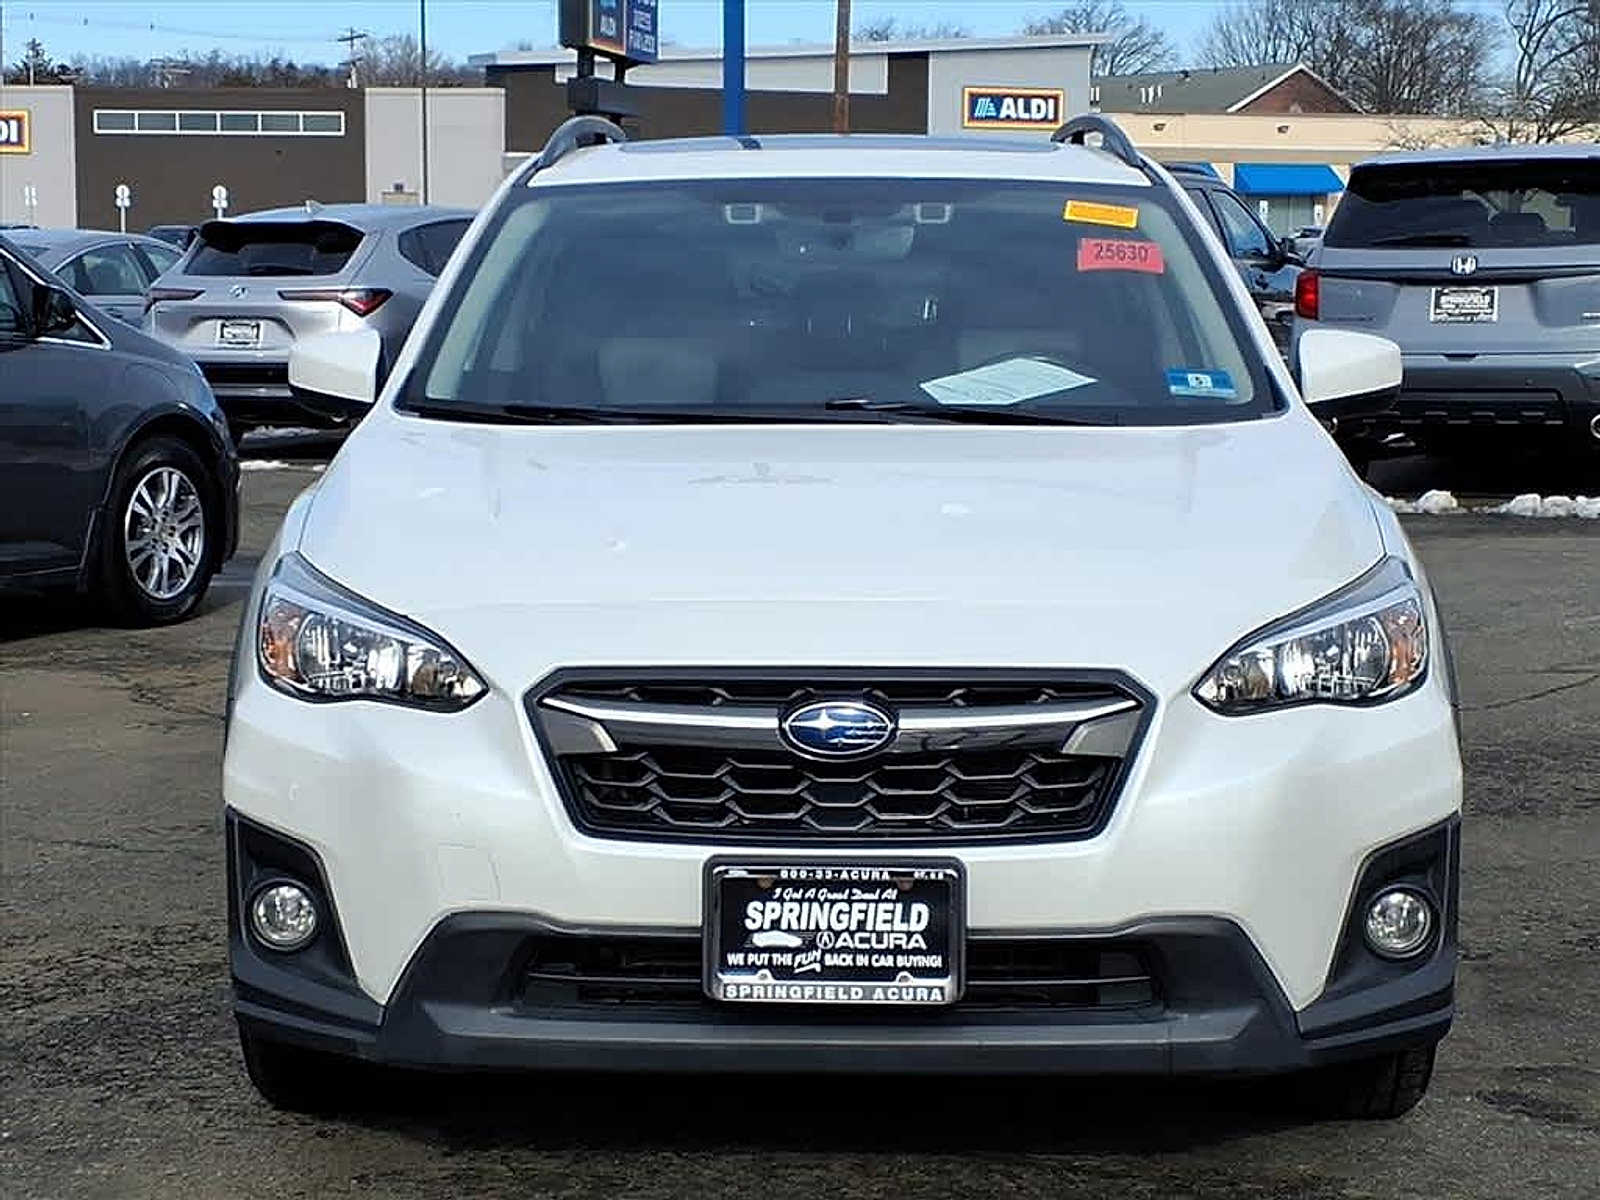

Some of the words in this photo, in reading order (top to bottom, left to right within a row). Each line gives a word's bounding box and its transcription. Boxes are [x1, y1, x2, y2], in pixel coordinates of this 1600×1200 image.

[1000, 97, 1055, 120] ALDI
[1093, 243, 1149, 263] 25630
[744, 901, 930, 932] SPRINGFIELD
[834, 933, 928, 950] ACURA
[727, 953, 745, 966] WE
[747, 953, 770, 967] PUT
[771, 953, 792, 966] THE
[825, 954, 854, 967] BACK
[856, 955, 869, 967] IN
[871, 955, 895, 967] CAR
[896, 955, 943, 968] BUYING!
[726, 985, 864, 1000] SPRINGFIELD
[872, 987, 943, 1001] ACURA
